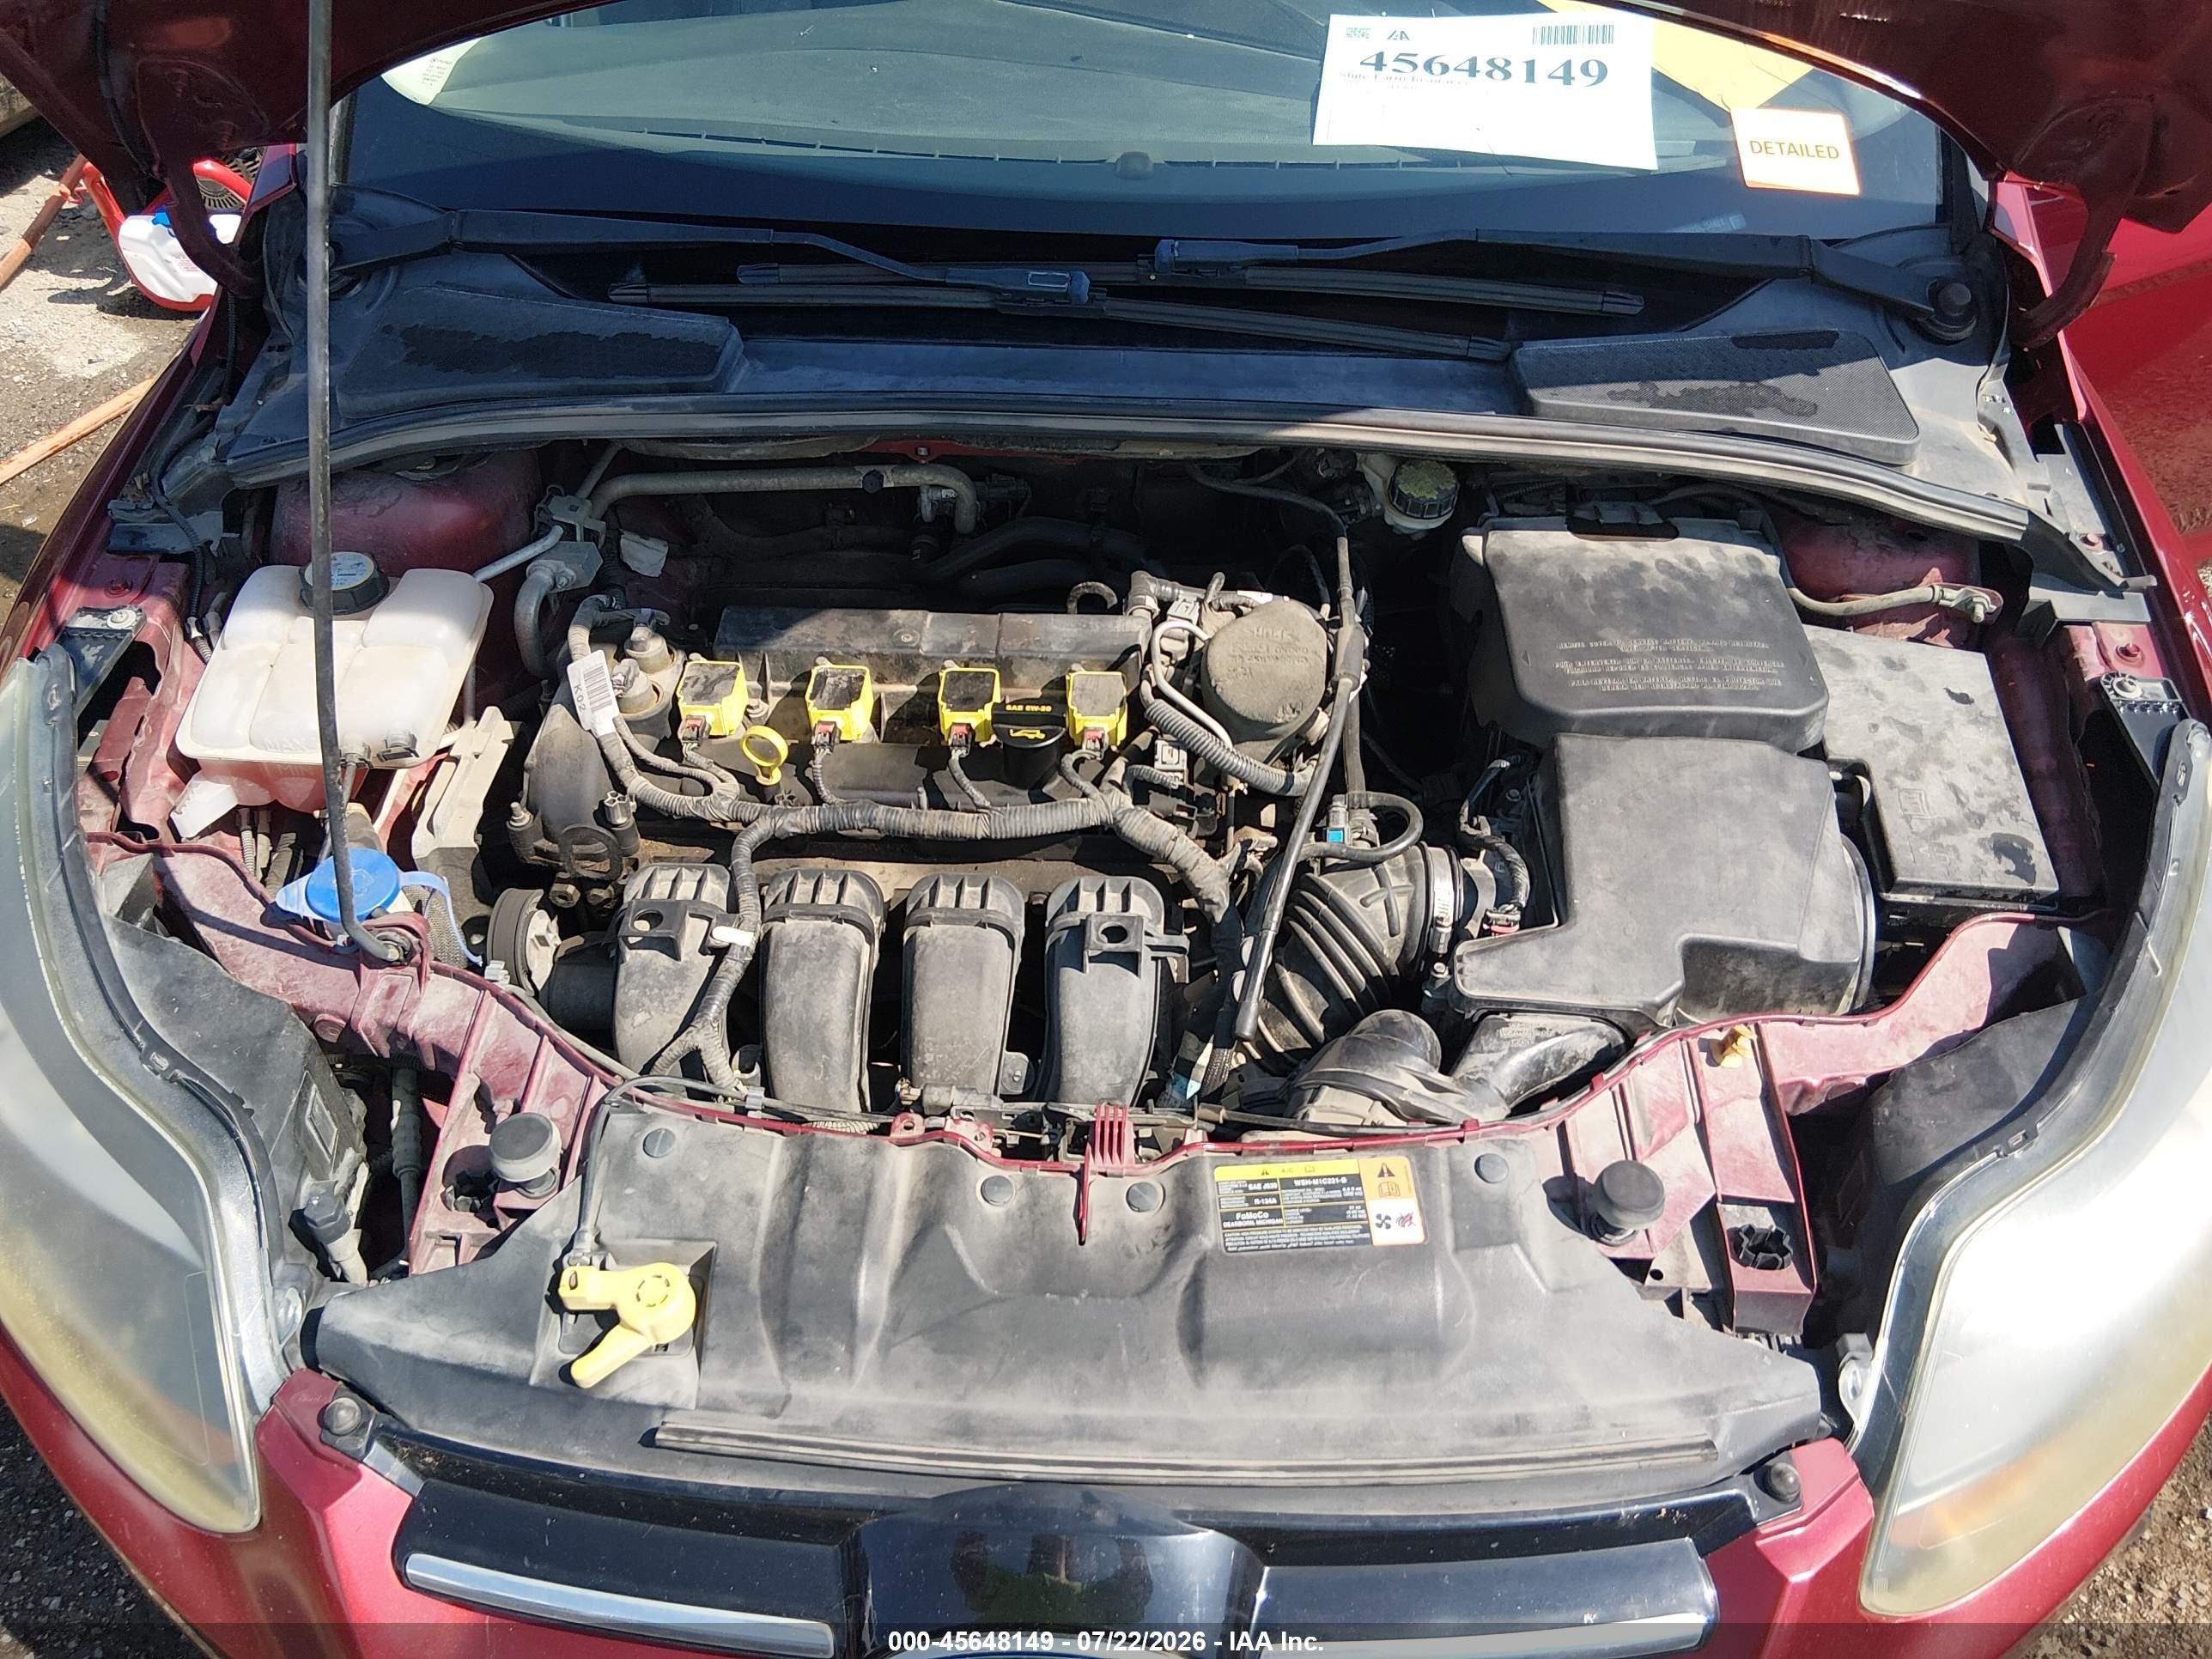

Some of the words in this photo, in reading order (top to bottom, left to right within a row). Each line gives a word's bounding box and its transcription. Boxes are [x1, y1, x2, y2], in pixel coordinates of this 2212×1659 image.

[1359, 51, 1608, 88] 45648149
[1749, 140, 1839, 160] DETAILED
[574, 684, 586, 713] K02
[1236, 1212, 1269, 1220] FoMoCo
